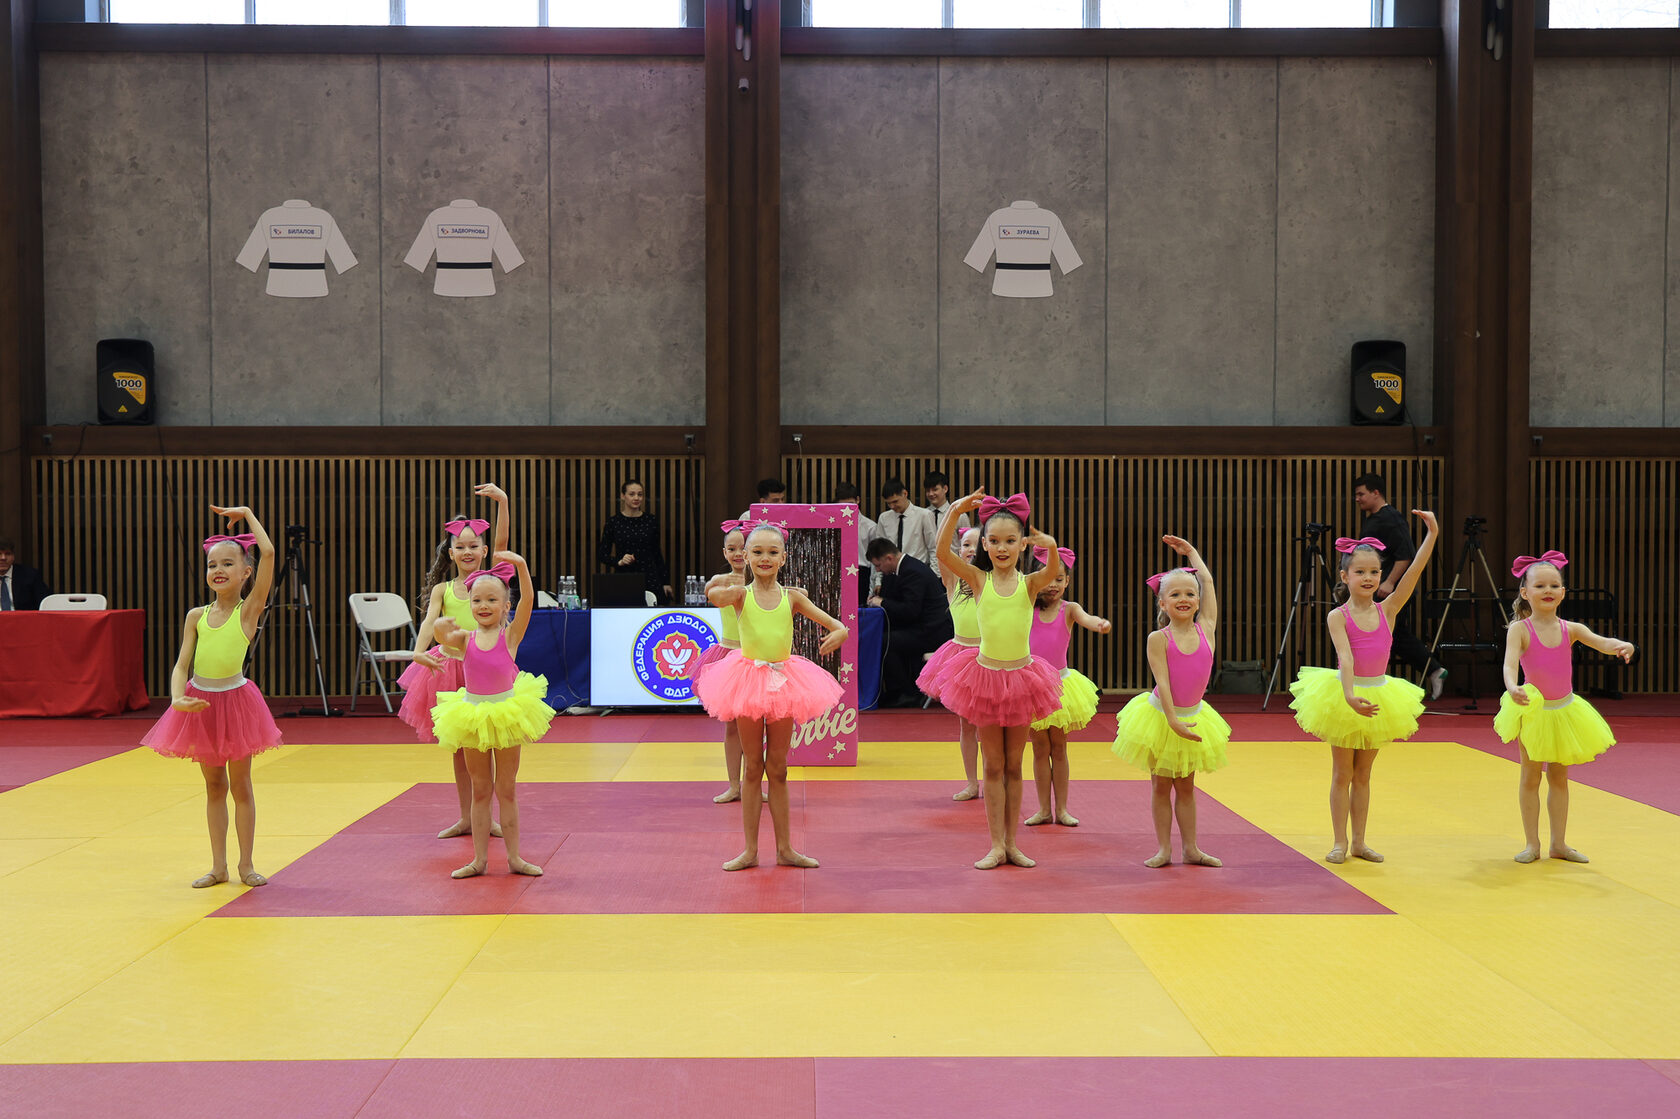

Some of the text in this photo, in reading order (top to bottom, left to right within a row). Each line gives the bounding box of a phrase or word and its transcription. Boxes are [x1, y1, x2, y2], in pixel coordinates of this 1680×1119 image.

[115, 379, 143, 388] 1000
[1374, 379, 1400, 388] 1000
[636, 619, 664, 681] ФЕДЕРАЦИЯ
[667, 615, 707, 634] ДЗЮДО
[664, 686, 690, 697] ФДР
